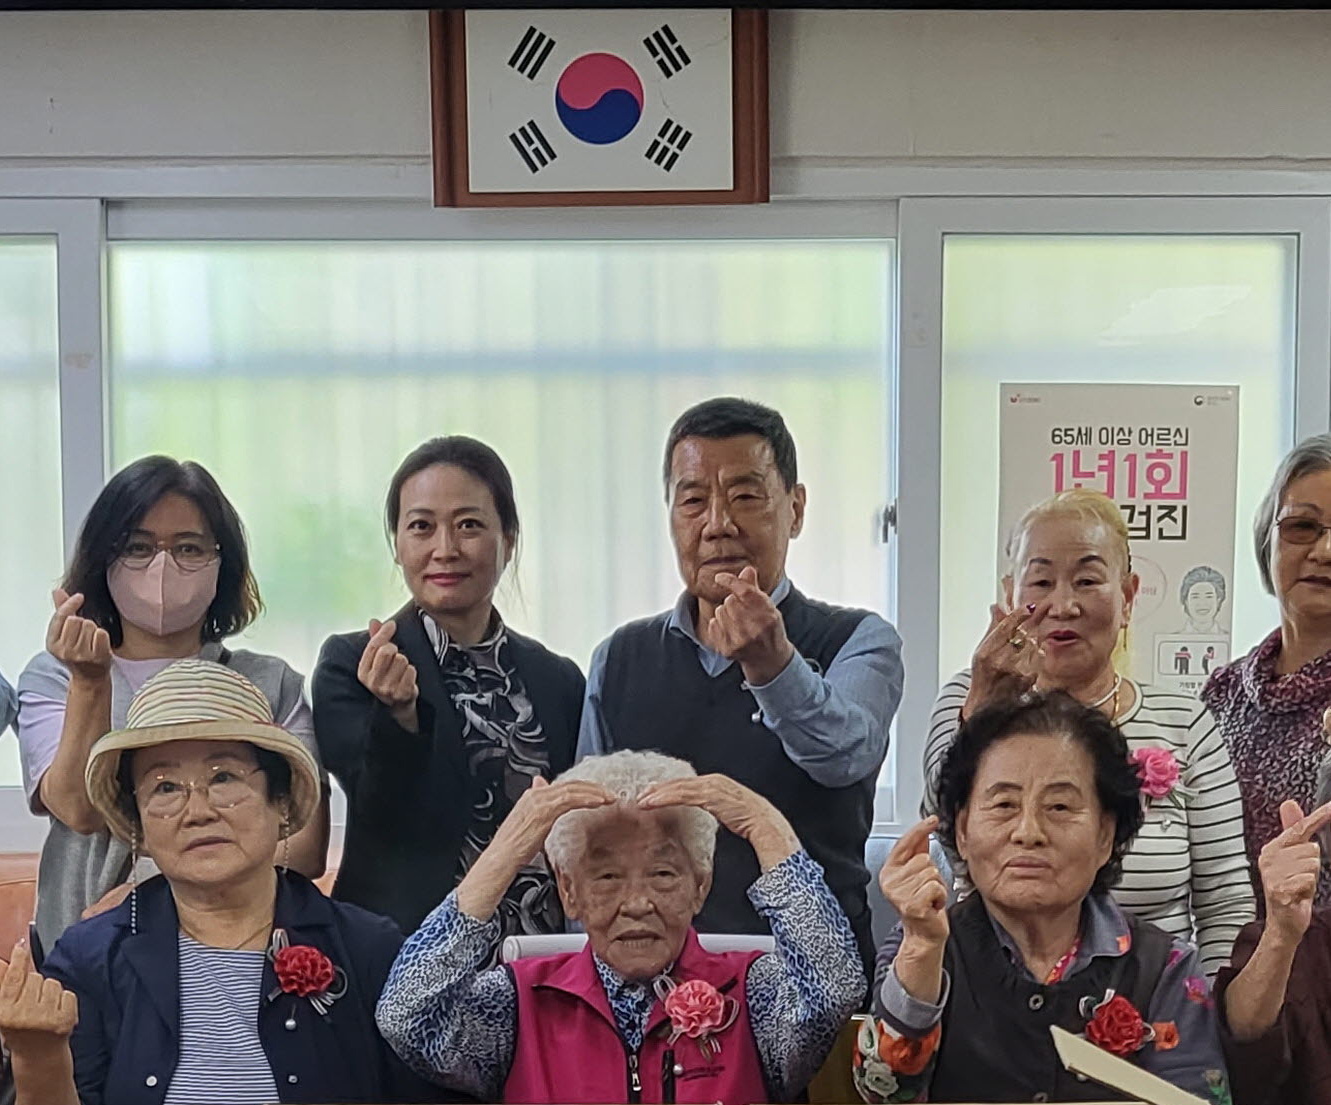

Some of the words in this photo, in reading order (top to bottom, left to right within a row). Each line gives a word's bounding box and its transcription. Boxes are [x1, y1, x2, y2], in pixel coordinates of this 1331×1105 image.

[1051, 426, 1093, 446] 65세
[1098, 426, 1133, 446] 이상
[1138, 427, 1189, 447] 어르신
[1119, 504, 1188, 540] 검진
